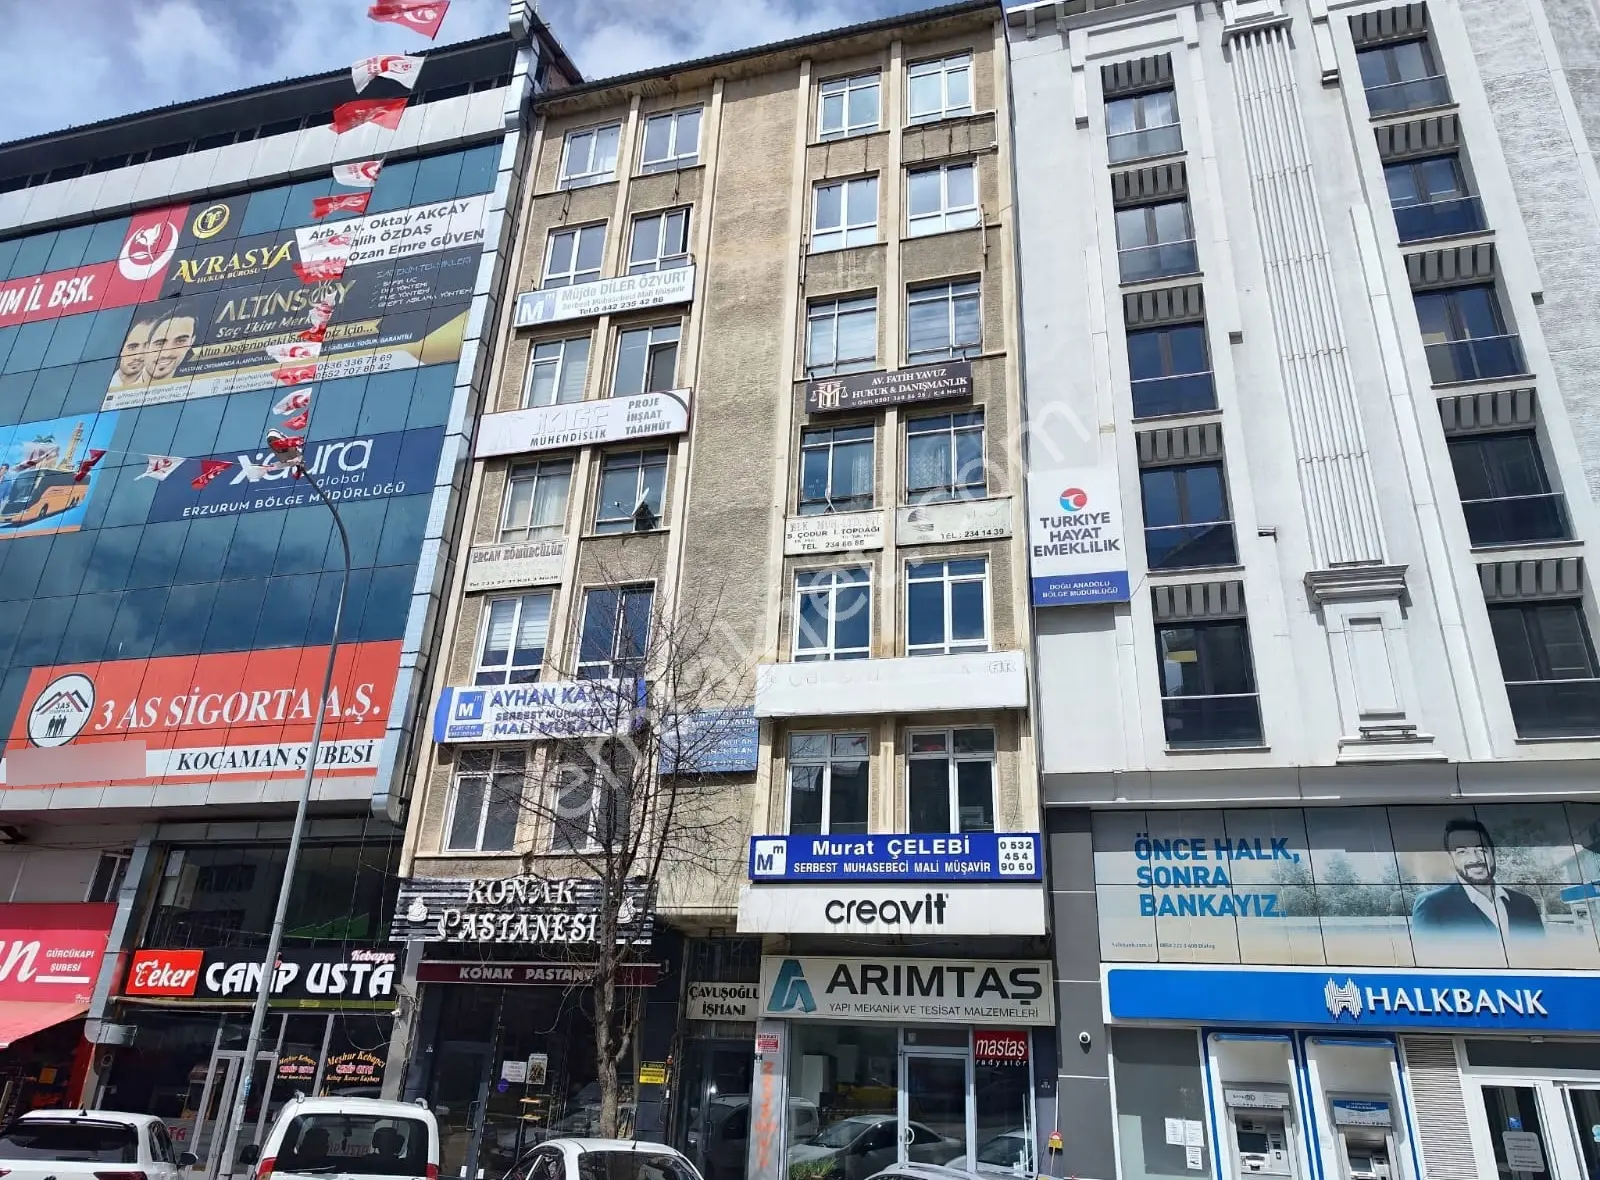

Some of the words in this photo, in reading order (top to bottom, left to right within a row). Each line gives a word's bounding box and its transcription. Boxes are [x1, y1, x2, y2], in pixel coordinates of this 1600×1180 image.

[309, 228, 338, 242] Arb.
[370, 213, 413, 231] Oktay
[415, 202, 470, 222] AKÇAY
[348, 248, 385, 262] Ozan
[389, 240, 426, 256] Emre
[430, 229, 485, 247] GÜVEN
[350, 234, 376, 249] alih
[380, 224, 432, 242] ÖZDAŞ
[171, 240, 296, 284] AVRASYA
[600, 278, 637, 295] DİLER
[639, 269, 689, 290] ÖZYURT
[0, 287, 26, 316] M
[24, 277, 44, 313] İL
[48, 274, 96, 309] BŞK.
[343, 366, 360, 376] 707
[377, 362, 391, 371] 42
[344, 357, 363, 367] 336
[852, 386, 889, 400] HUKUK
[898, 376, 969, 394] DANIŞMANLIK
[871, 377, 885, 386] AV.
[886, 371, 914, 384] FATİH
[915, 368, 948, 380] YAVUZ
[628, 398, 661, 410] PROJE
[626, 409, 664, 424] İNŞAAT
[529, 429, 608, 447] MÜHENDİSLİK
[624, 420, 672, 436] TAAHHÜT
[316, 472, 366, 488] global
[182, 500, 251, 518] ERZURUM
[253, 490, 304, 509] BÖLGE
[308, 481, 406, 503] MÜDÜRLÜĞÜ
[825, 541, 841, 549] 234
[940, 532, 958, 540] TEL
[964, 529, 980, 538] 234
[1049, 526, 1102, 543] HAYAT
[1072, 580, 1111, 589] ANADOLU
[94, 699, 116, 731] 3
[116, 696, 162, 730] AS
[164, 685, 313, 727] SİGORTA
[320, 683, 381, 725] A.Ş.
[489, 688, 557, 708] AYHAN
[176, 747, 291, 771] KOCAMAN
[812, 839, 875, 856] Murat
[887, 835, 970, 860] ÇELEBİ
[1010, 841, 1033, 850] 532
[1004, 852, 1029, 861] 454
[1134, 832, 1208, 861] ÖNCE
[1213, 836, 1301, 865] HALK,
[793, 861, 838, 873] SERBEST
[843, 860, 909, 873] MUHASEBECİ
[914, 859, 940, 873] MALİ
[944, 860, 991, 875] MÜŞAVİR
[1000, 862, 1017, 872] 90
[1136, 865, 1232, 889] SONRA
[467, 879, 577, 905] KONAK
[824, 893, 948, 925] creavit
[1139, 893, 1288, 918] BANKAYIZ.
[45, 948, 96, 959] GÜRCÜKAPI
[50, 962, 82, 973] ŞUBESİ
[459, 966, 514, 980] KONAK
[305, 961, 395, 999] USTA
[825, 963, 1043, 1006] ARIMTAŞ
[702, 1000, 746, 1018] İŞHANI
[829, 1003, 850, 1012] YAPI
[853, 1003, 900, 1014] MEKANİK
[903, 1004, 916, 1014] VE
[919, 1004, 960, 1016] TESİSAT
[964, 1005, 1039, 1019] MALZEMELERİ
[1364, 986, 1549, 1016] HALKBANK
[975, 1036, 1026, 1061] mastaş
